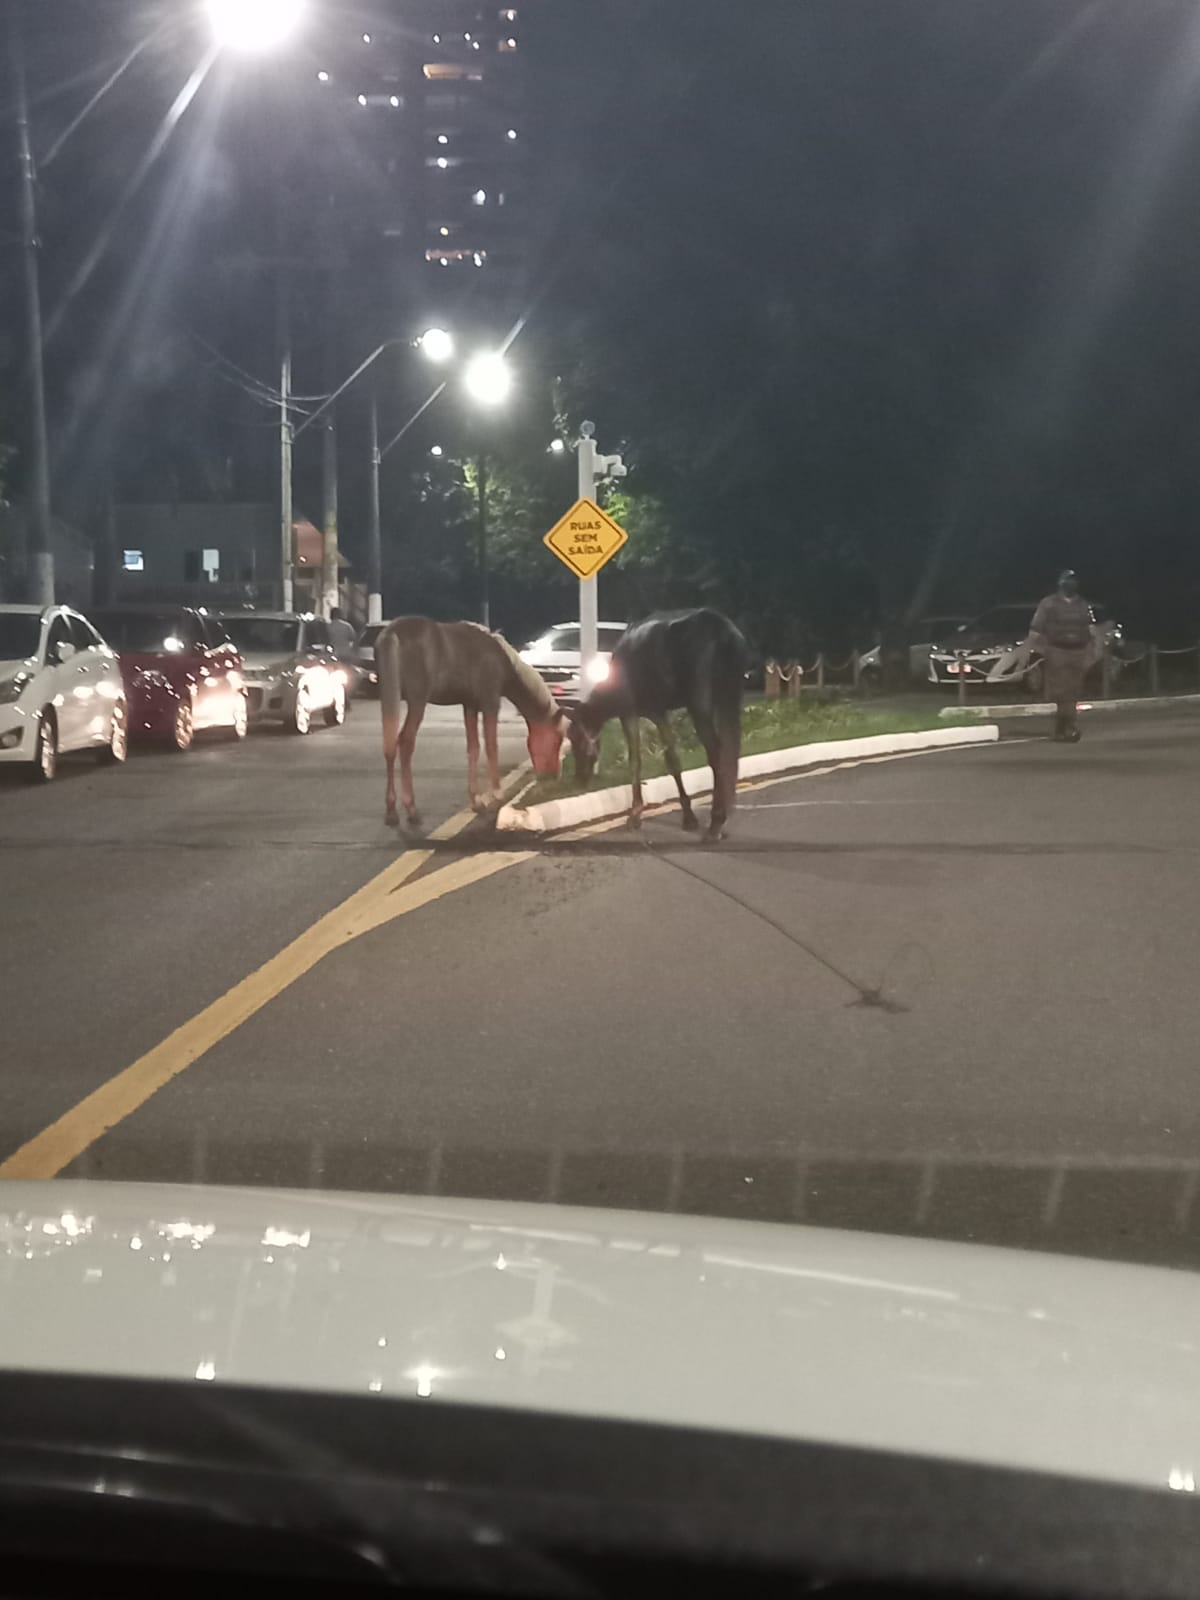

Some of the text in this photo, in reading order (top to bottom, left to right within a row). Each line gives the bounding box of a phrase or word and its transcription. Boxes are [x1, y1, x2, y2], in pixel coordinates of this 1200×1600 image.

[570, 521, 601, 531] RUAS
[574, 534, 598, 543] SEM
[568, 544, 603, 555] SAÍDA
